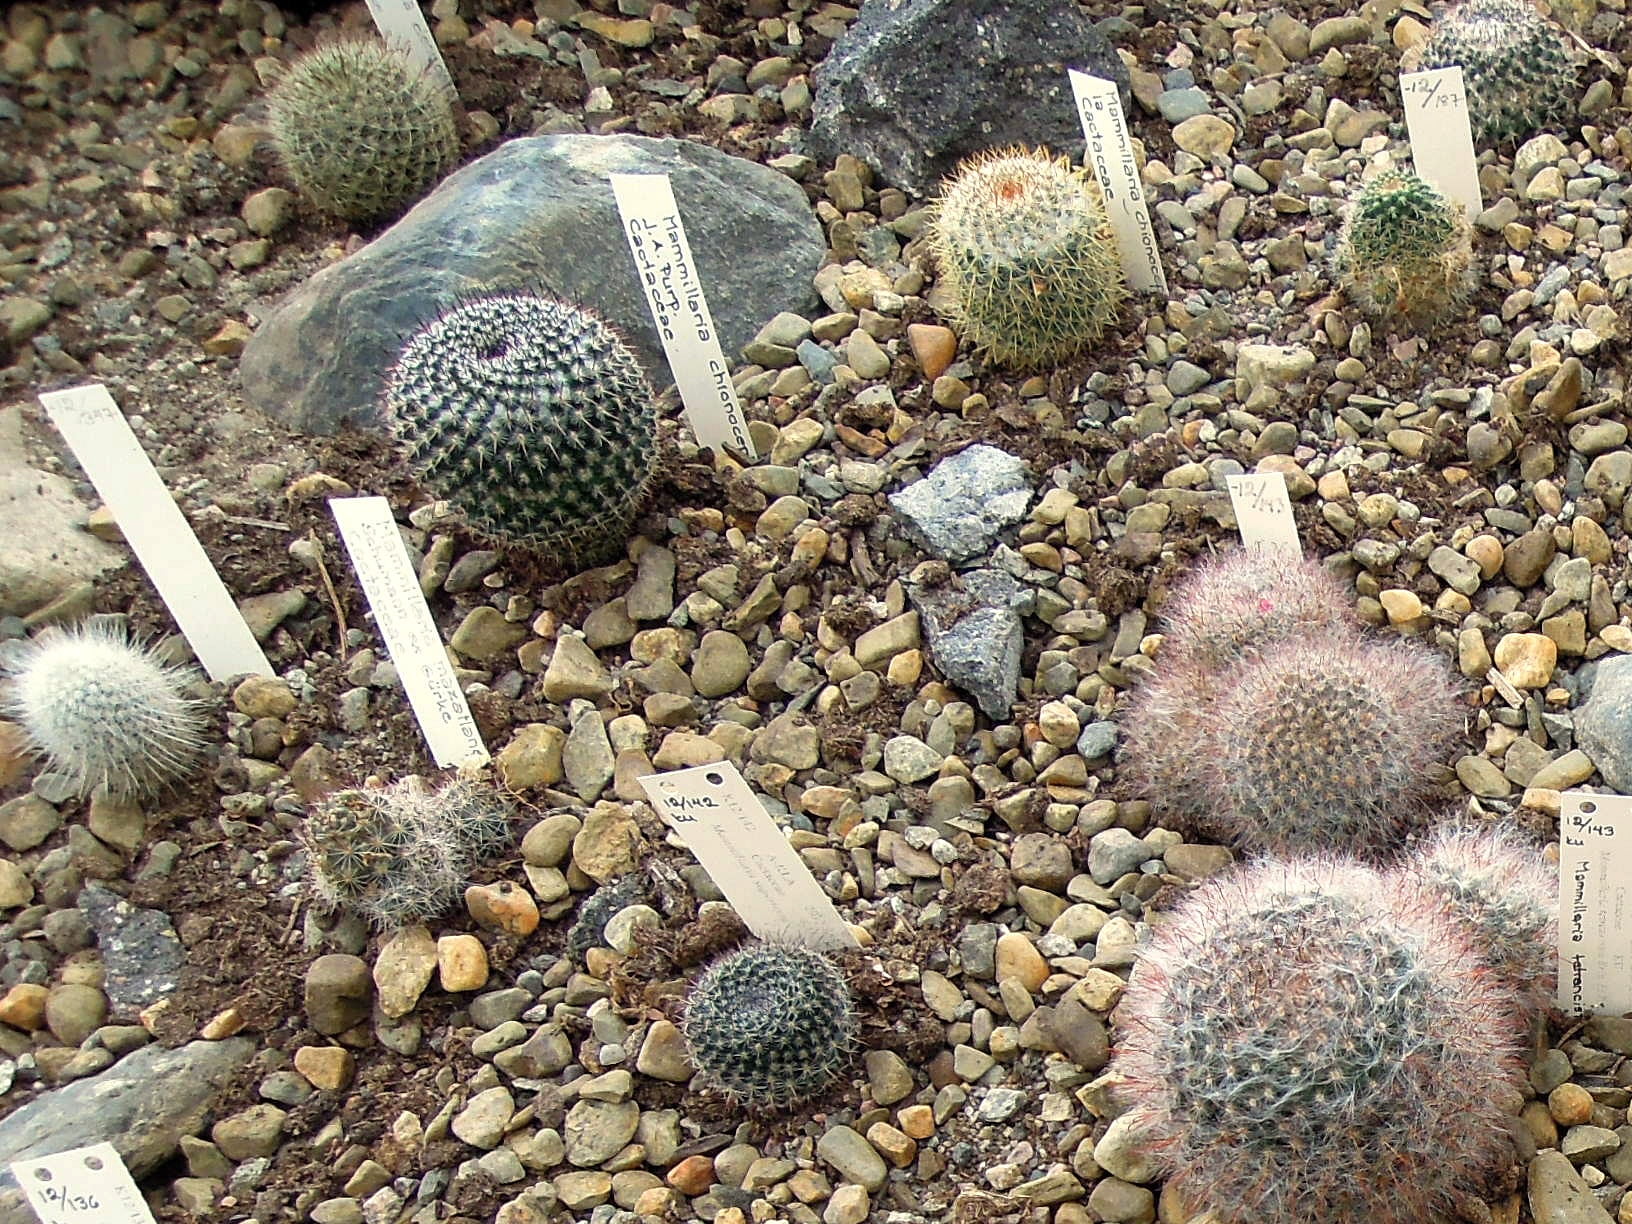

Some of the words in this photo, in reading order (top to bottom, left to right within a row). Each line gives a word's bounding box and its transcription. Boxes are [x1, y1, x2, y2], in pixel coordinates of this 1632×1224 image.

[1082, 97, 1114, 201] Cactaceae
[630, 218, 674, 341] Cactaceae
[663, 215, 711, 342] Mammillaria
[1566, 816, 1615, 837] 12/143
[38, 1186, 100, 1211] 12/136
